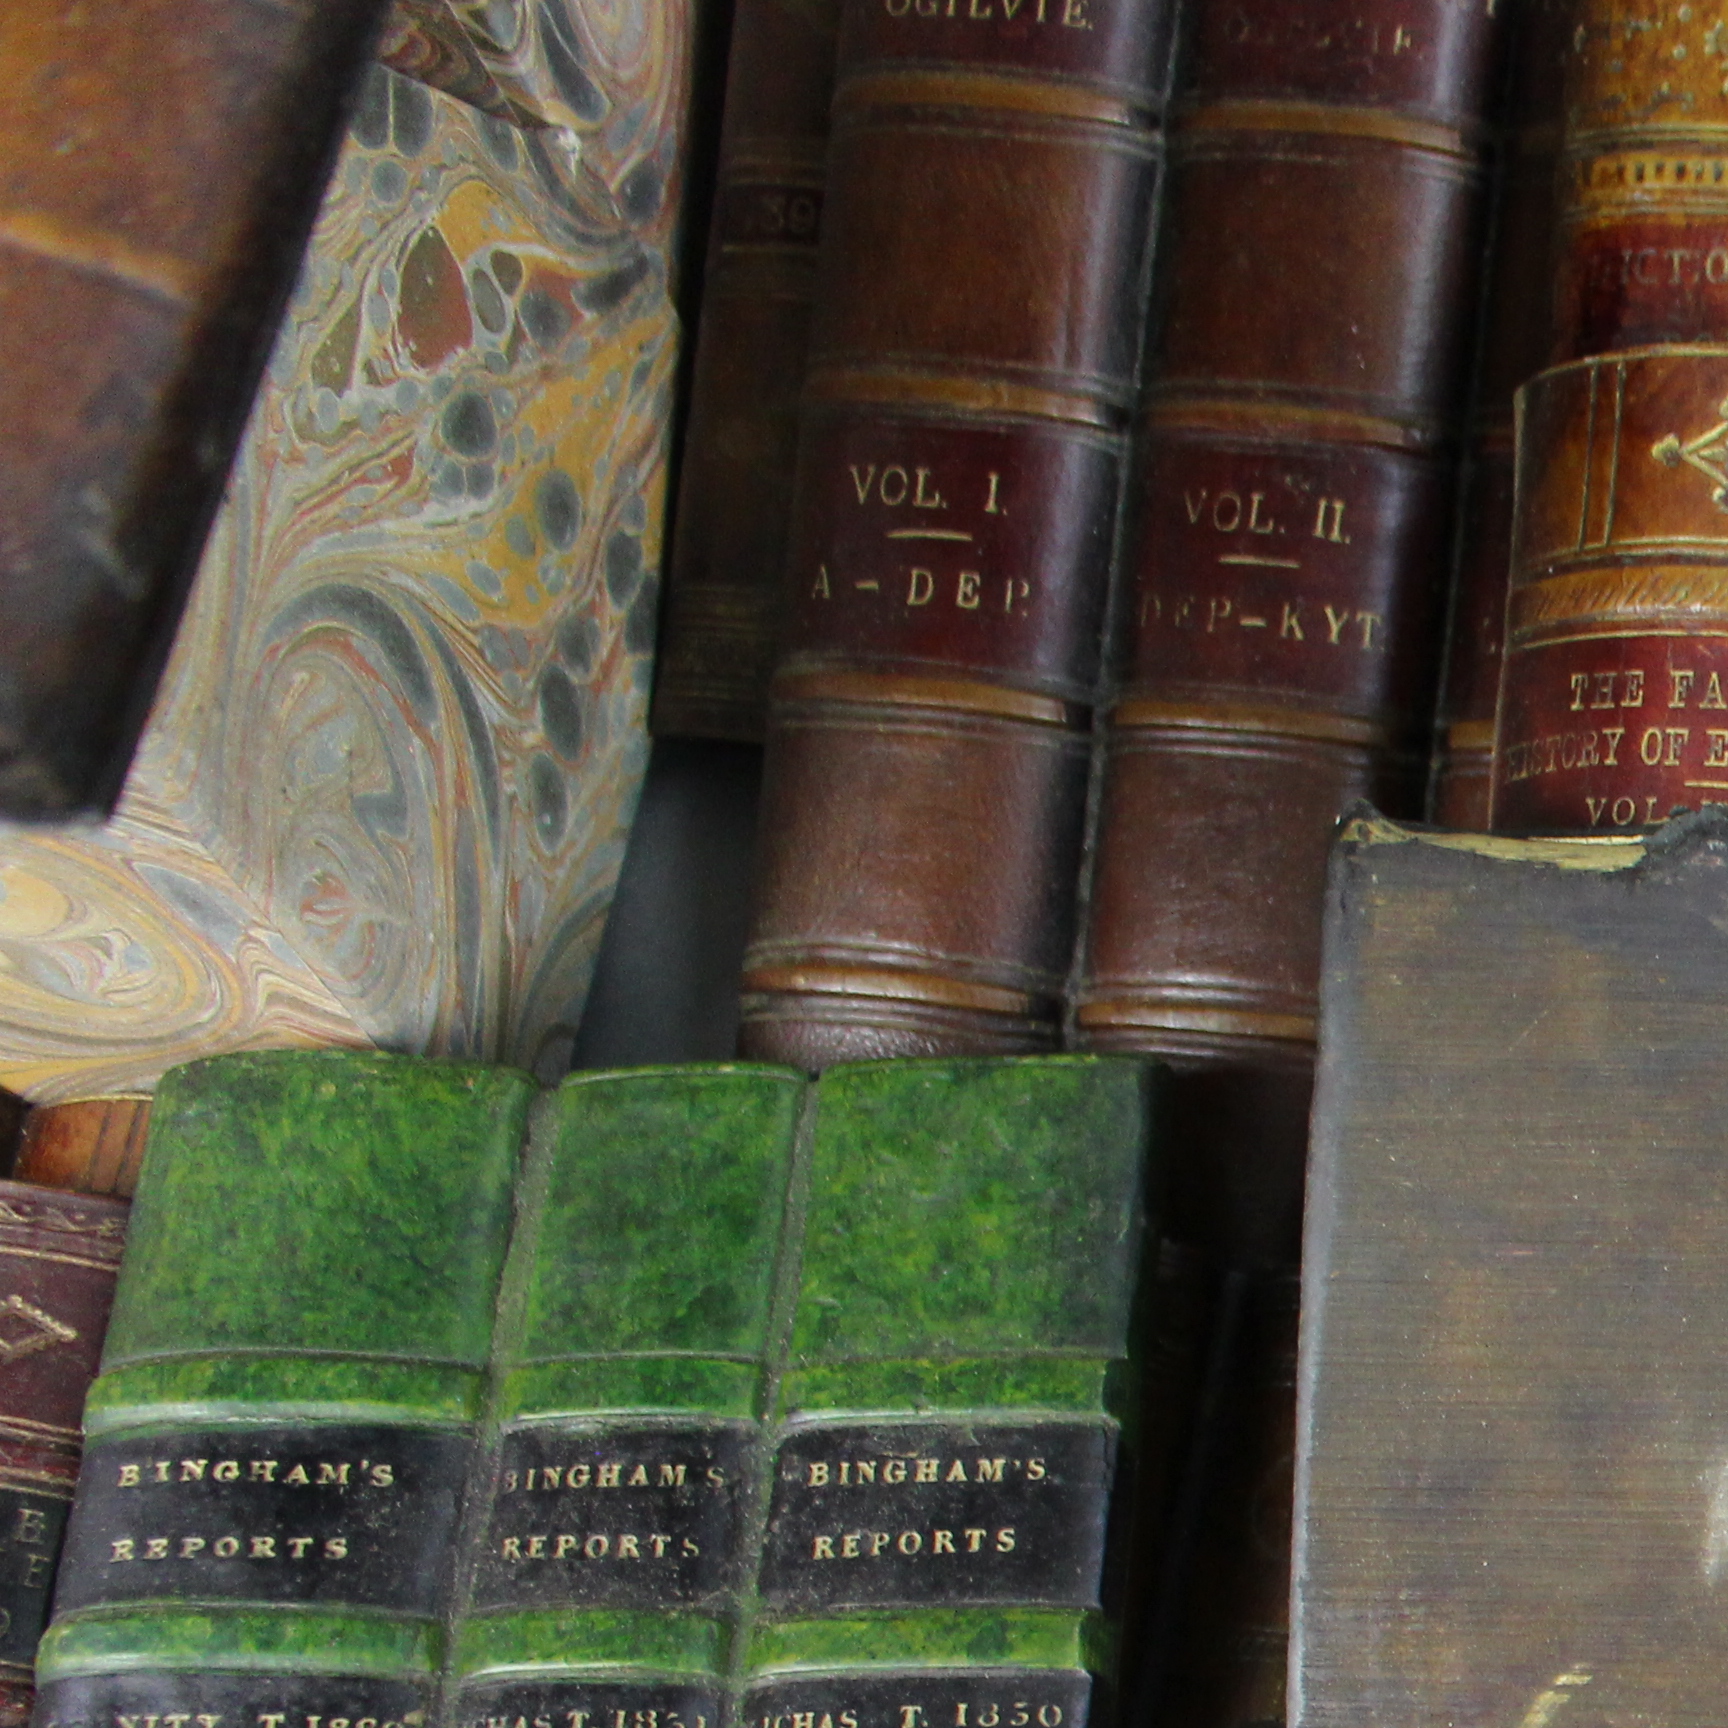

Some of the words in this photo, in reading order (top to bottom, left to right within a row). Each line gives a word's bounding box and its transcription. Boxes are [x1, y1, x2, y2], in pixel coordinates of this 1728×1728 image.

[849, 463, 948, 510] VOL.
[984, 470, 1009, 517] I.
[1184, 490, 1287, 534] VOL.
[1311, 497, 1352, 545] II.
[1570, 669, 1645, 712] THE
[1504, 727, 1627, 784] HISTORY
[1639, 727, 1690, 768] OF
[117, 1458, 395, 1489] BINGHAM'S
[807, 1457, 1048, 1488] BINGHAM'S
[110, 1535, 349, 1564] REPORTS
[501, 1532, 702, 1561] REPORTS
[812, 1527, 1018, 1560] REPORTS
